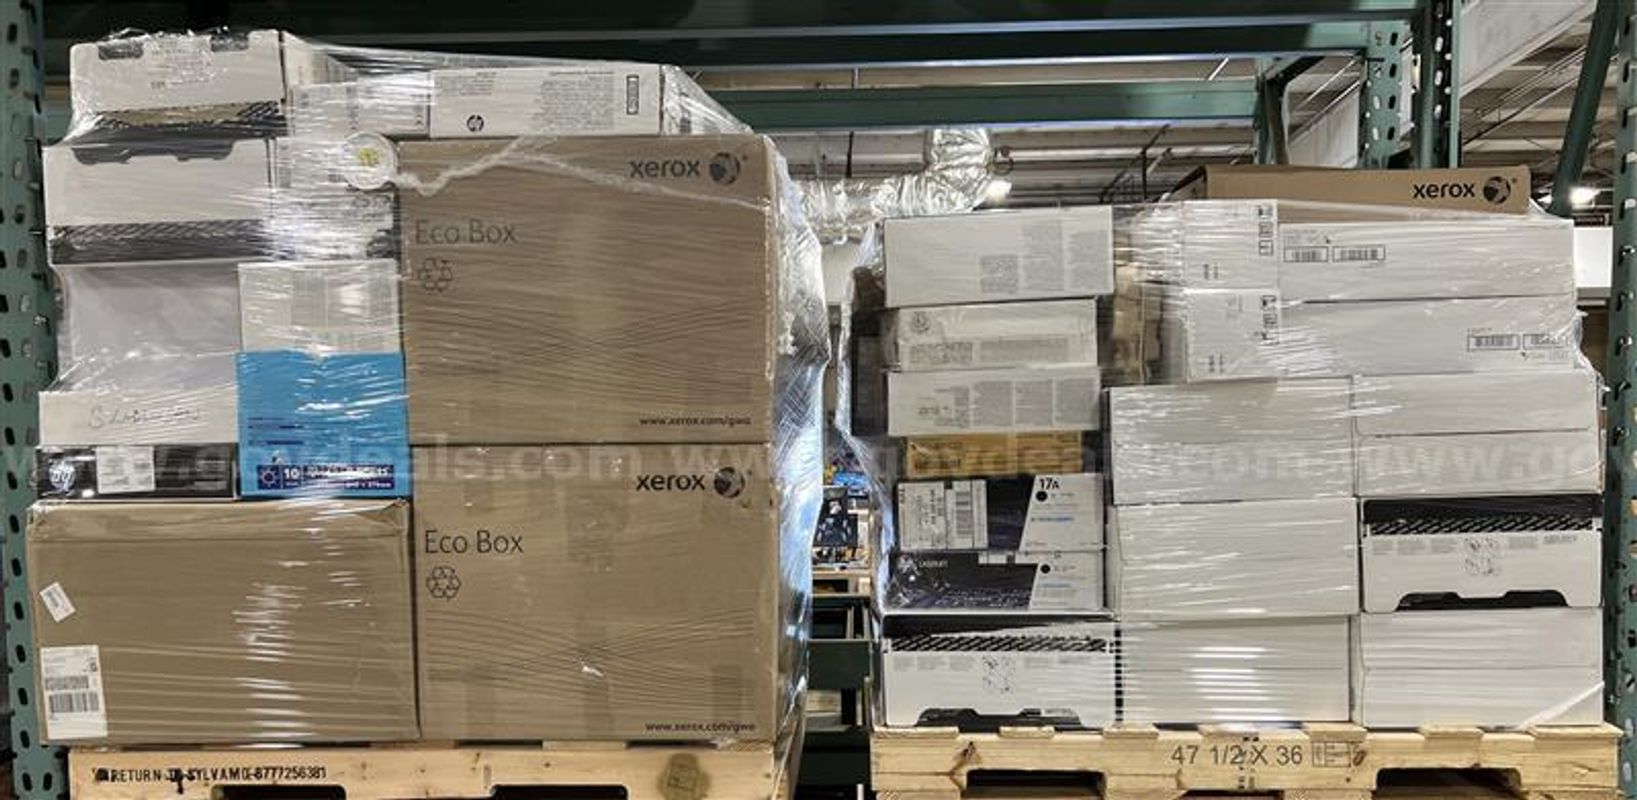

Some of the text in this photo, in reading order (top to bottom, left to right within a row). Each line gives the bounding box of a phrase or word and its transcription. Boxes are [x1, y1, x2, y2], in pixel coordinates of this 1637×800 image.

[630, 158, 701, 178] xerox
[1413, 182, 1475, 200] xerox
[415, 219, 517, 244] Eco Box
[636, 473, 706, 491] xerox
[1039, 477, 1060, 490] 17A
[424, 529, 524, 554] Eco Box
[1170, 745, 1199, 765] 47
[1209, 745, 1244, 765] 1/2
[1252, 745, 1268, 764] X
[1276, 745, 1303, 765] 36
[110, 768, 161, 783] RETURN
